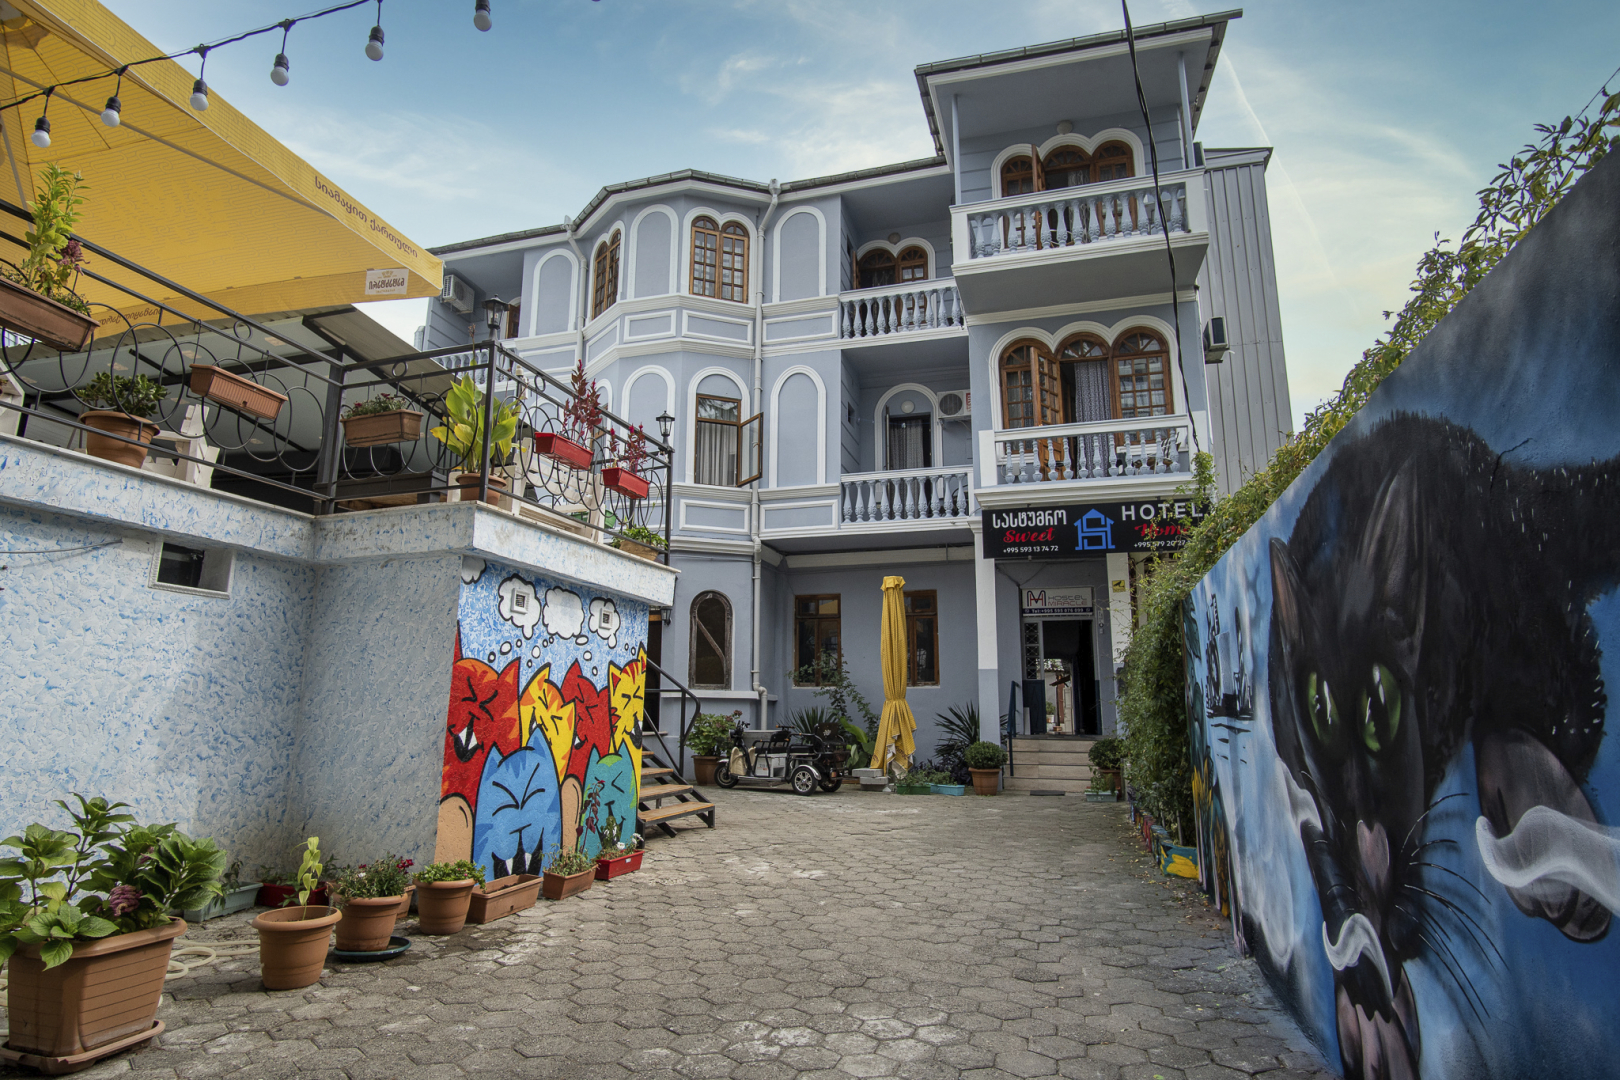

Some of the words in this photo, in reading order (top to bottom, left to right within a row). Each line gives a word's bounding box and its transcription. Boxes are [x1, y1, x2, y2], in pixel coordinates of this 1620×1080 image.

[314, 175, 368, 223] სიამაყით
[369, 218, 418, 258] ქართული
[992, 509, 1067, 528] სასტუმრო
[1121, 502, 1203, 520] HOTEL
[1003, 527, 1055, 543] Sweet
